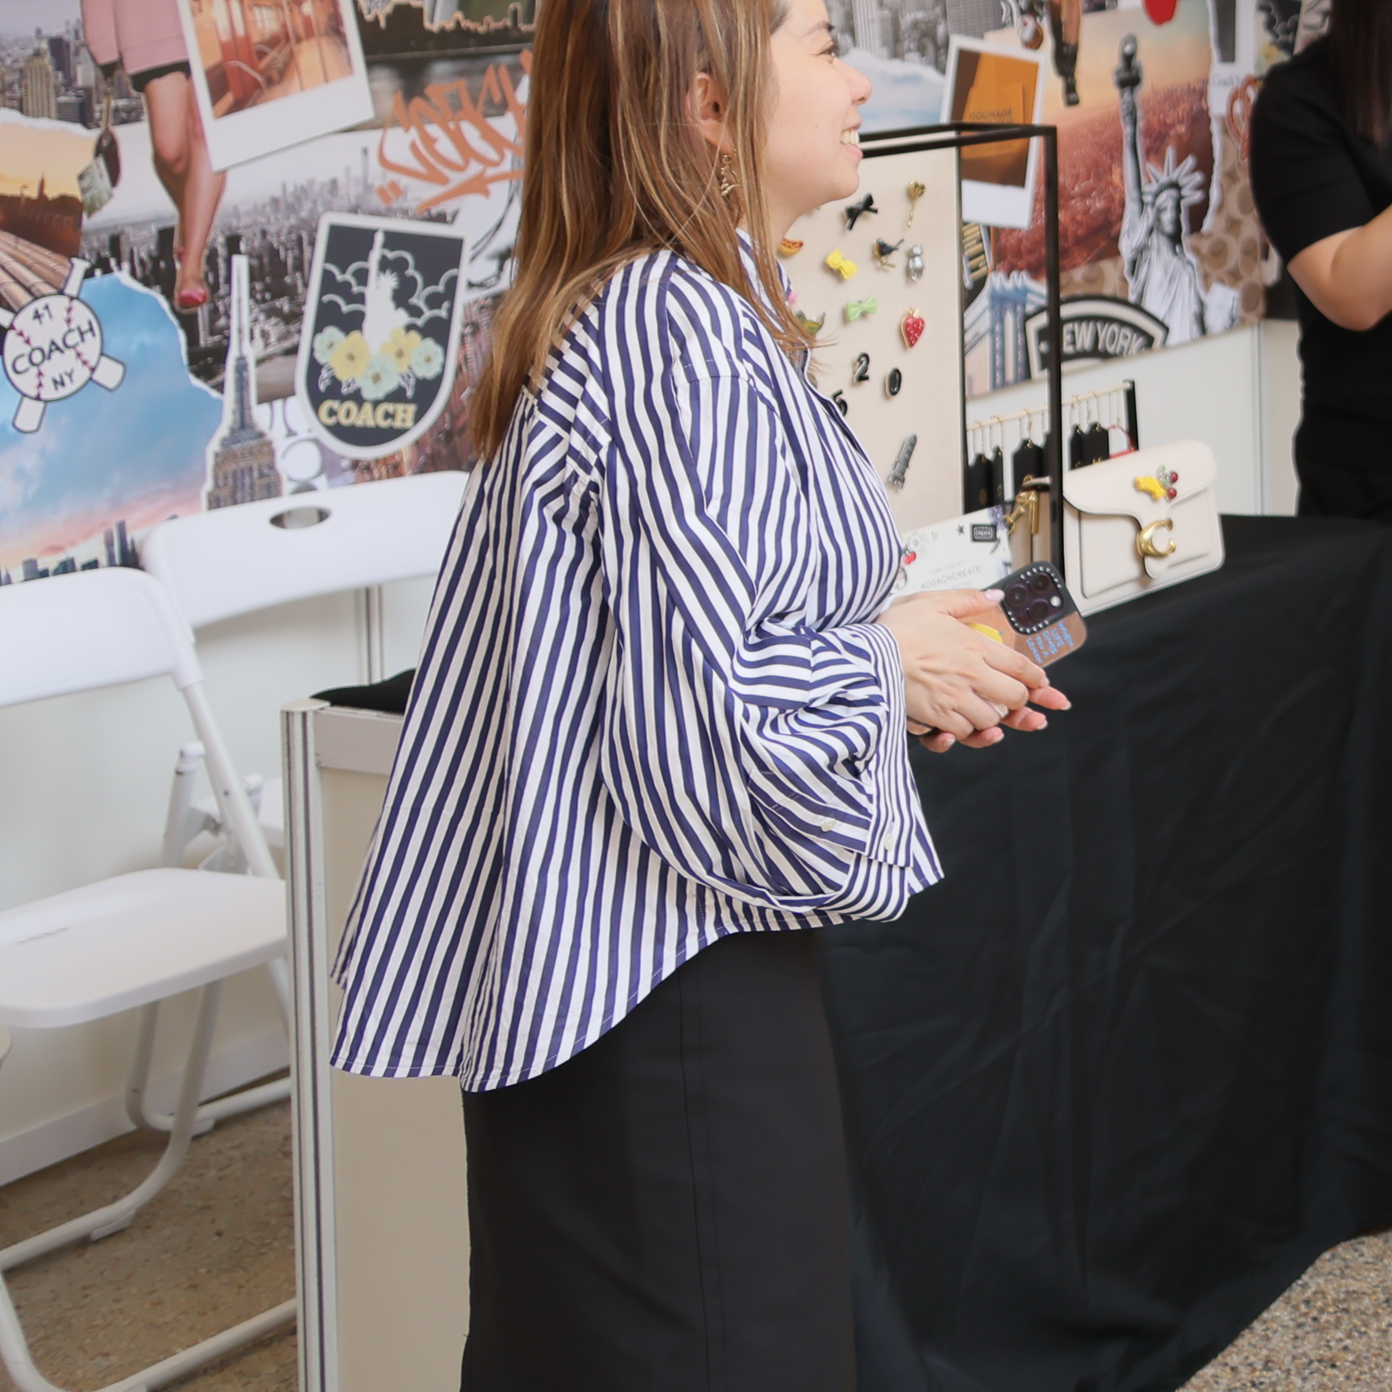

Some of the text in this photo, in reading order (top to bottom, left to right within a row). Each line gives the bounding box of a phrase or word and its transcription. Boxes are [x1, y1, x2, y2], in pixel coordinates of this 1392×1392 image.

[32, 304, 53, 325] 41
[12, 319, 96, 375] COACH
[1062, 320, 1095, 354] EW
[51, 369, 74, 390] NY
[854, 353, 869, 382] 2
[318, 399, 418, 429] COACH
[921, 565, 981, 589] #COACHCREATE
